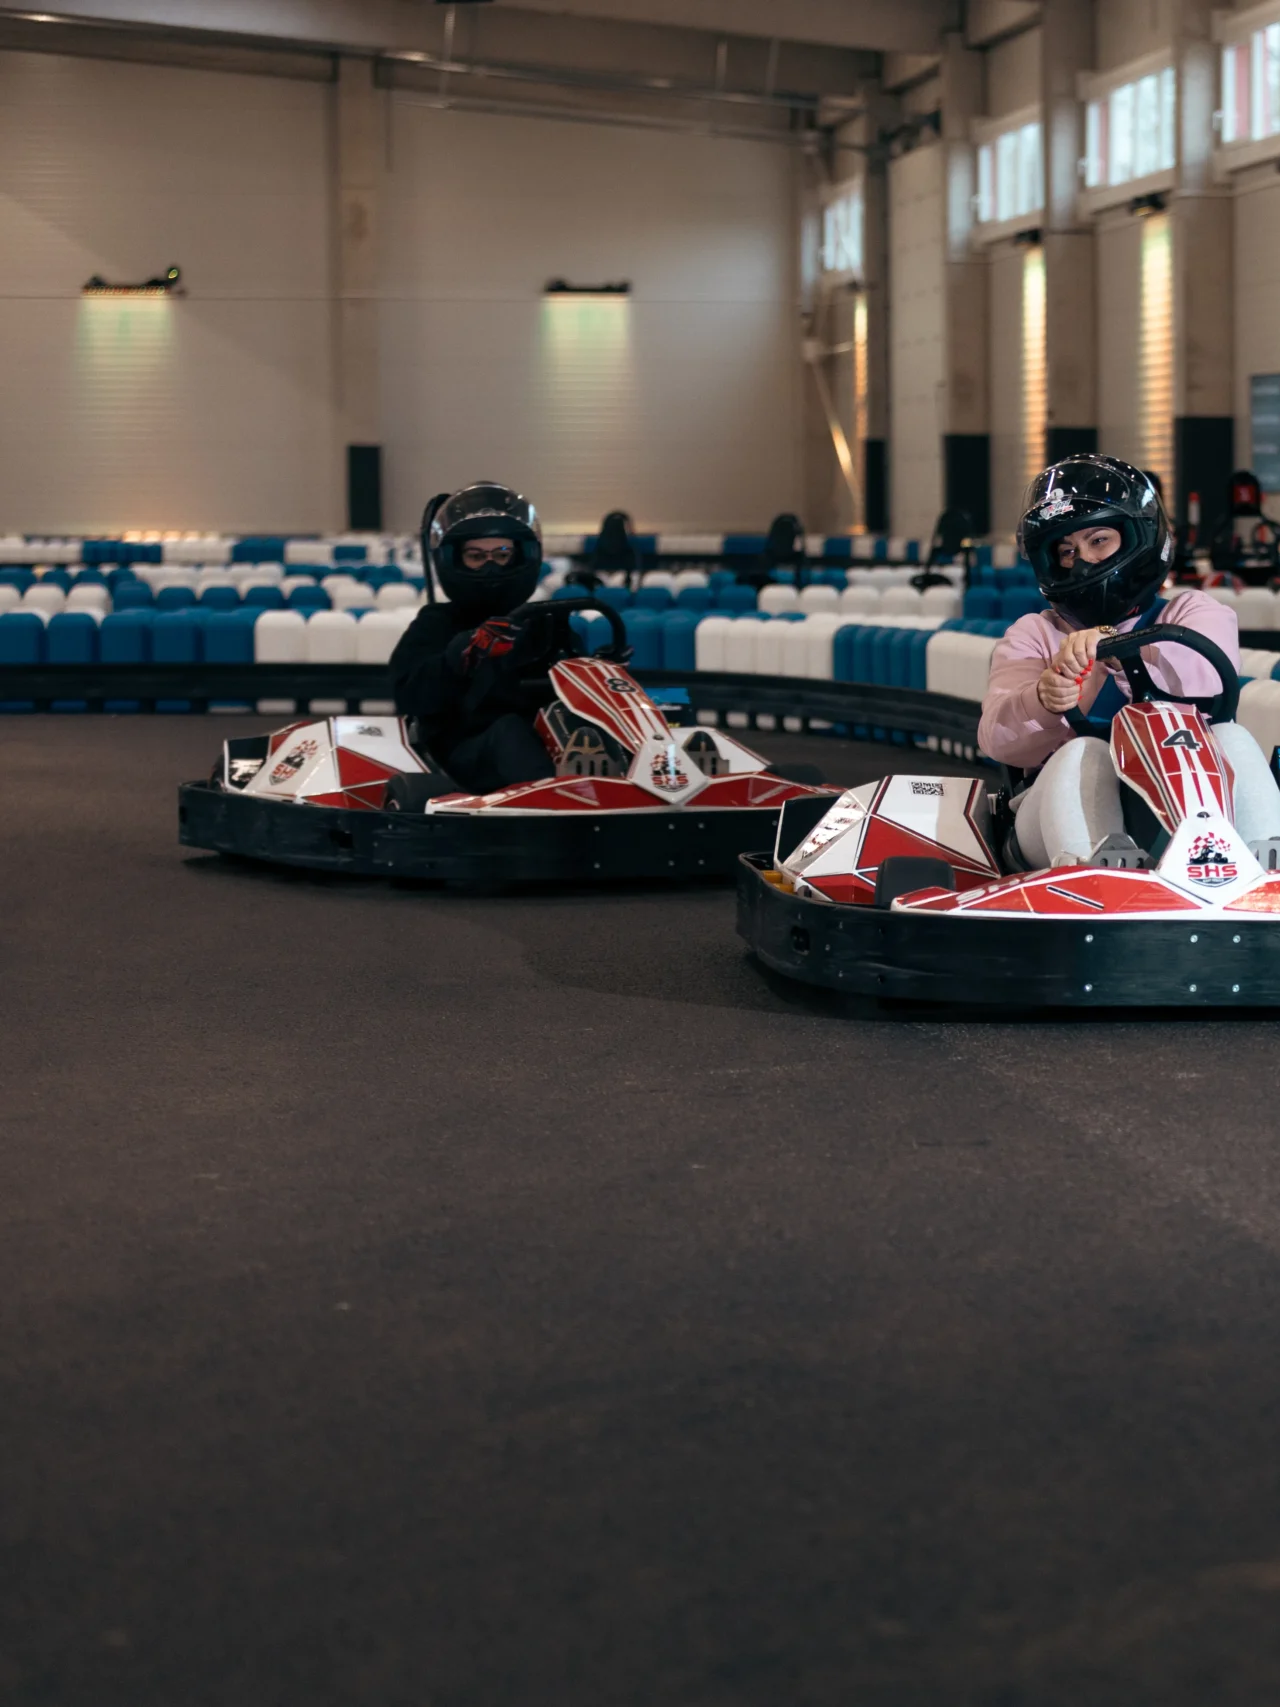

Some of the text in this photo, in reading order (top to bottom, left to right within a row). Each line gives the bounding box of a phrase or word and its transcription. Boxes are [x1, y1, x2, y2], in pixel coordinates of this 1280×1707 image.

[606, 678, 637, 693] 8
[1163, 729, 1201, 750] 4
[1187, 864, 1238, 878] SHS
